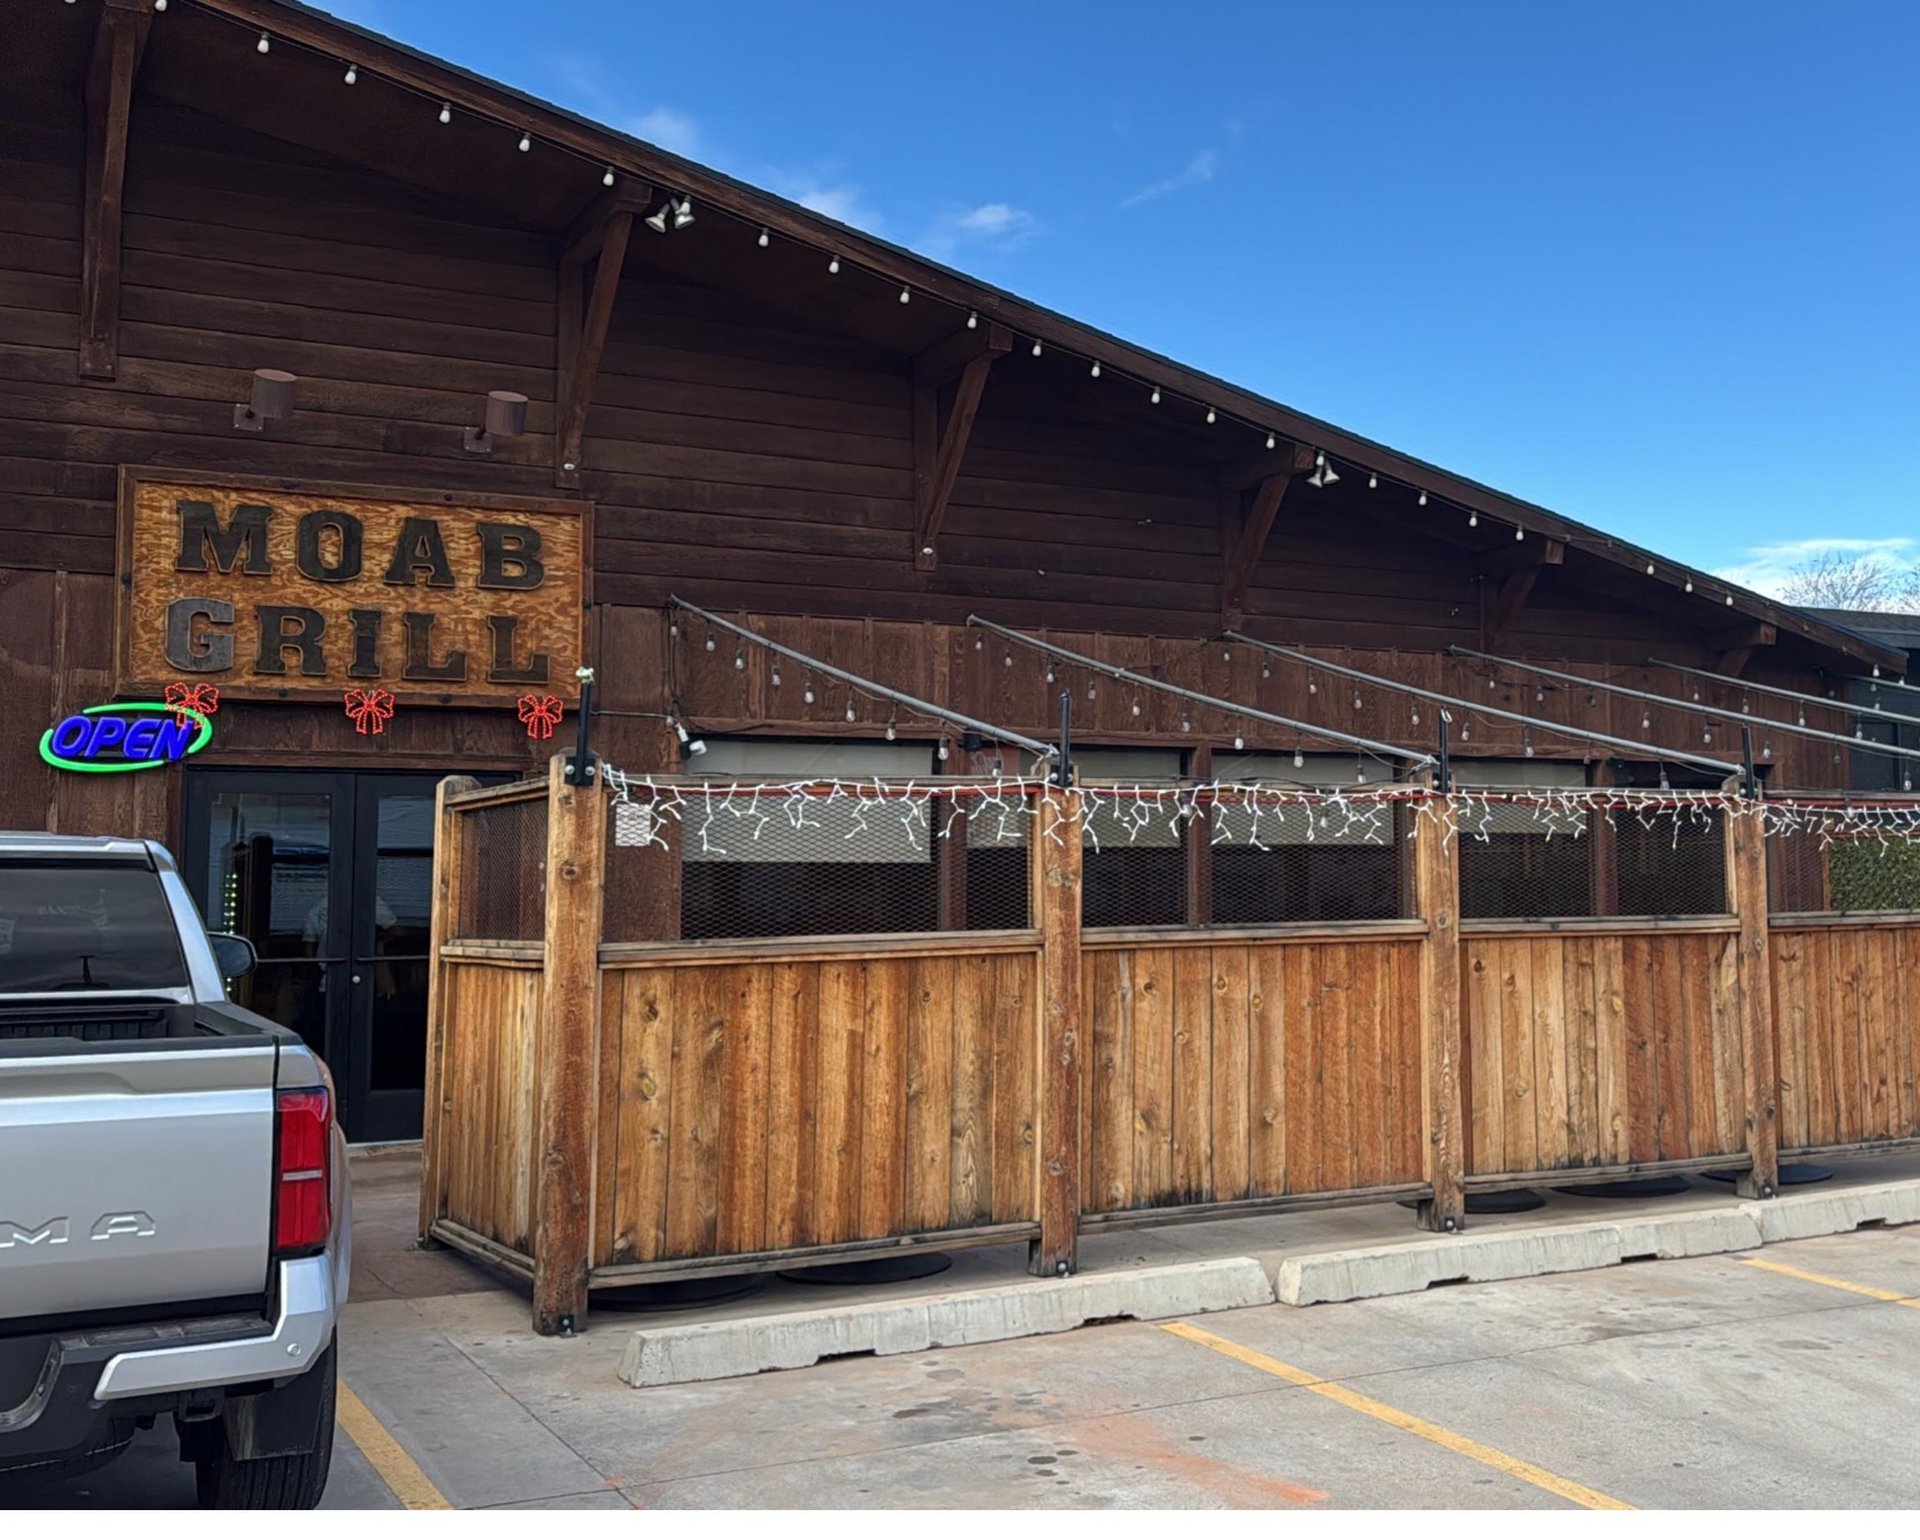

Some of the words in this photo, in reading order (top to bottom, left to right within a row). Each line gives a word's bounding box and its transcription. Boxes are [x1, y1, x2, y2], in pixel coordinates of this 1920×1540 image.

[175, 501, 545, 590] MOAB
[164, 598, 551, 684] GRILL
[52, 715, 194, 761] OPEN
